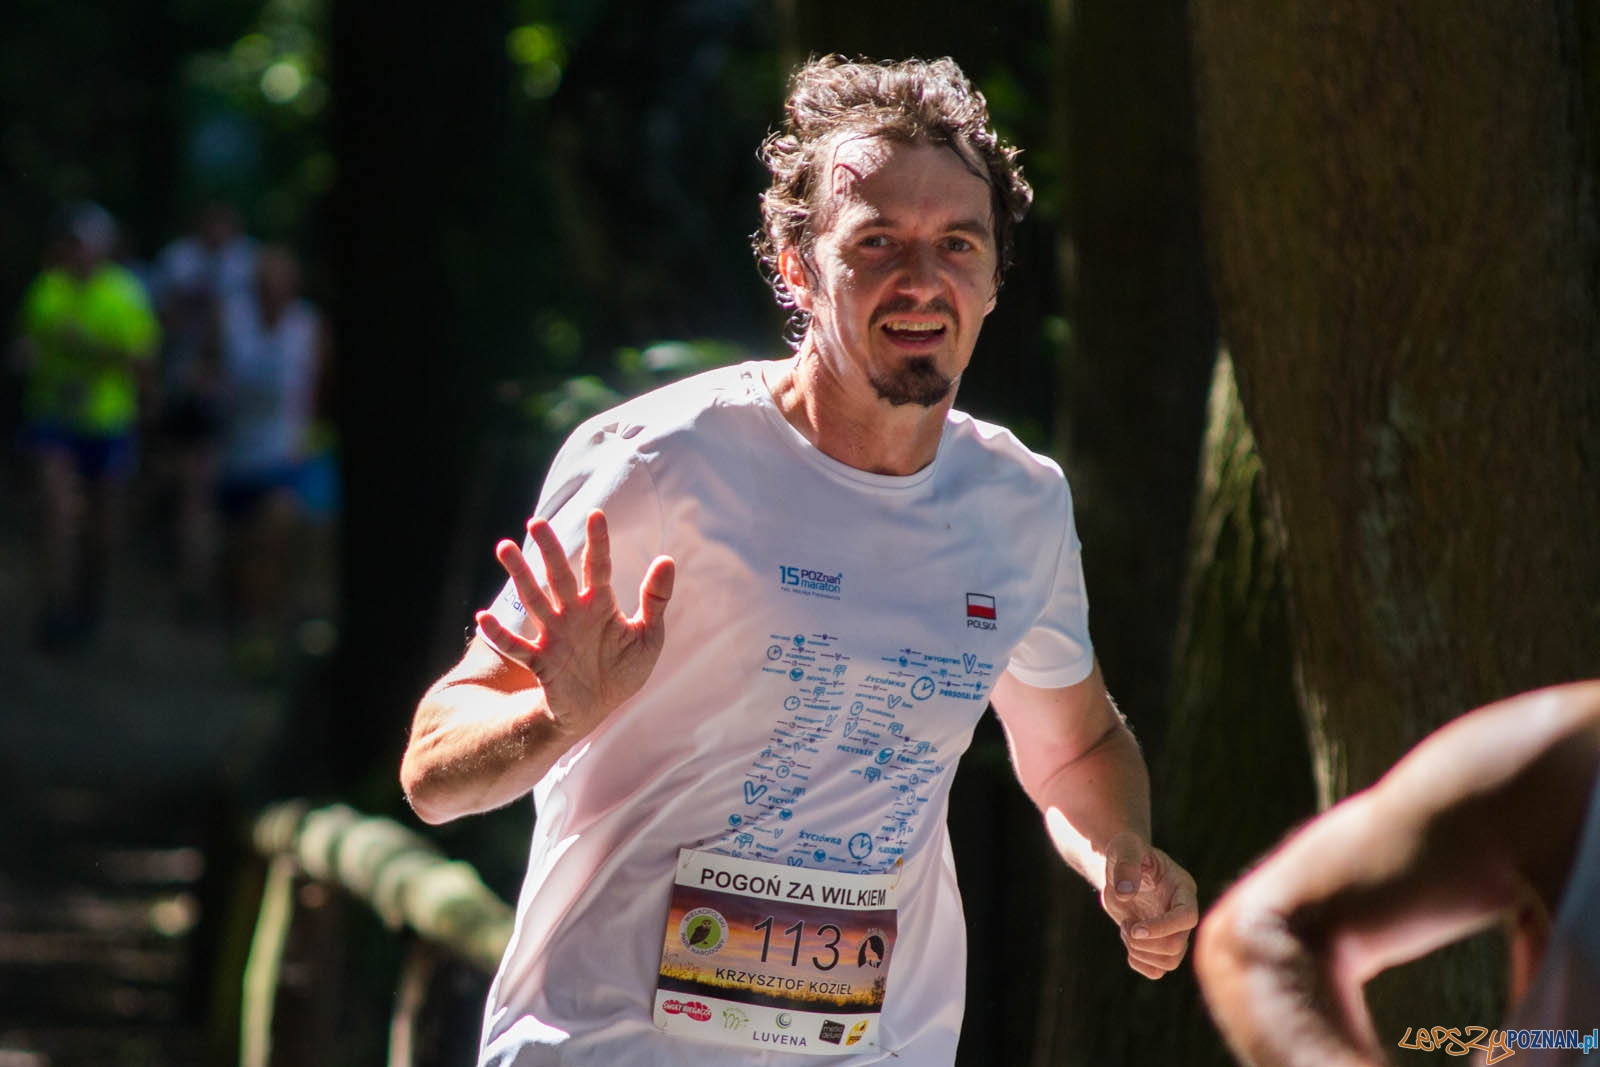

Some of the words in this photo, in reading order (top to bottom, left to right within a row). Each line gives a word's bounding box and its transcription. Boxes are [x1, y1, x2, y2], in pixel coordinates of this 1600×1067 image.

[779, 565, 800, 585] 15
[801, 580, 840, 593] maraton
[967, 619, 997, 630] POLSKA
[700, 868, 781, 897] POGOŃ
[786, 882, 815, 901] ZA
[821, 886, 886, 906] WILKIEM
[754, 916, 841, 971] 113
[715, 967, 805, 991] KRZYSZTOF
[752, 1031, 808, 1047] LUVENA
